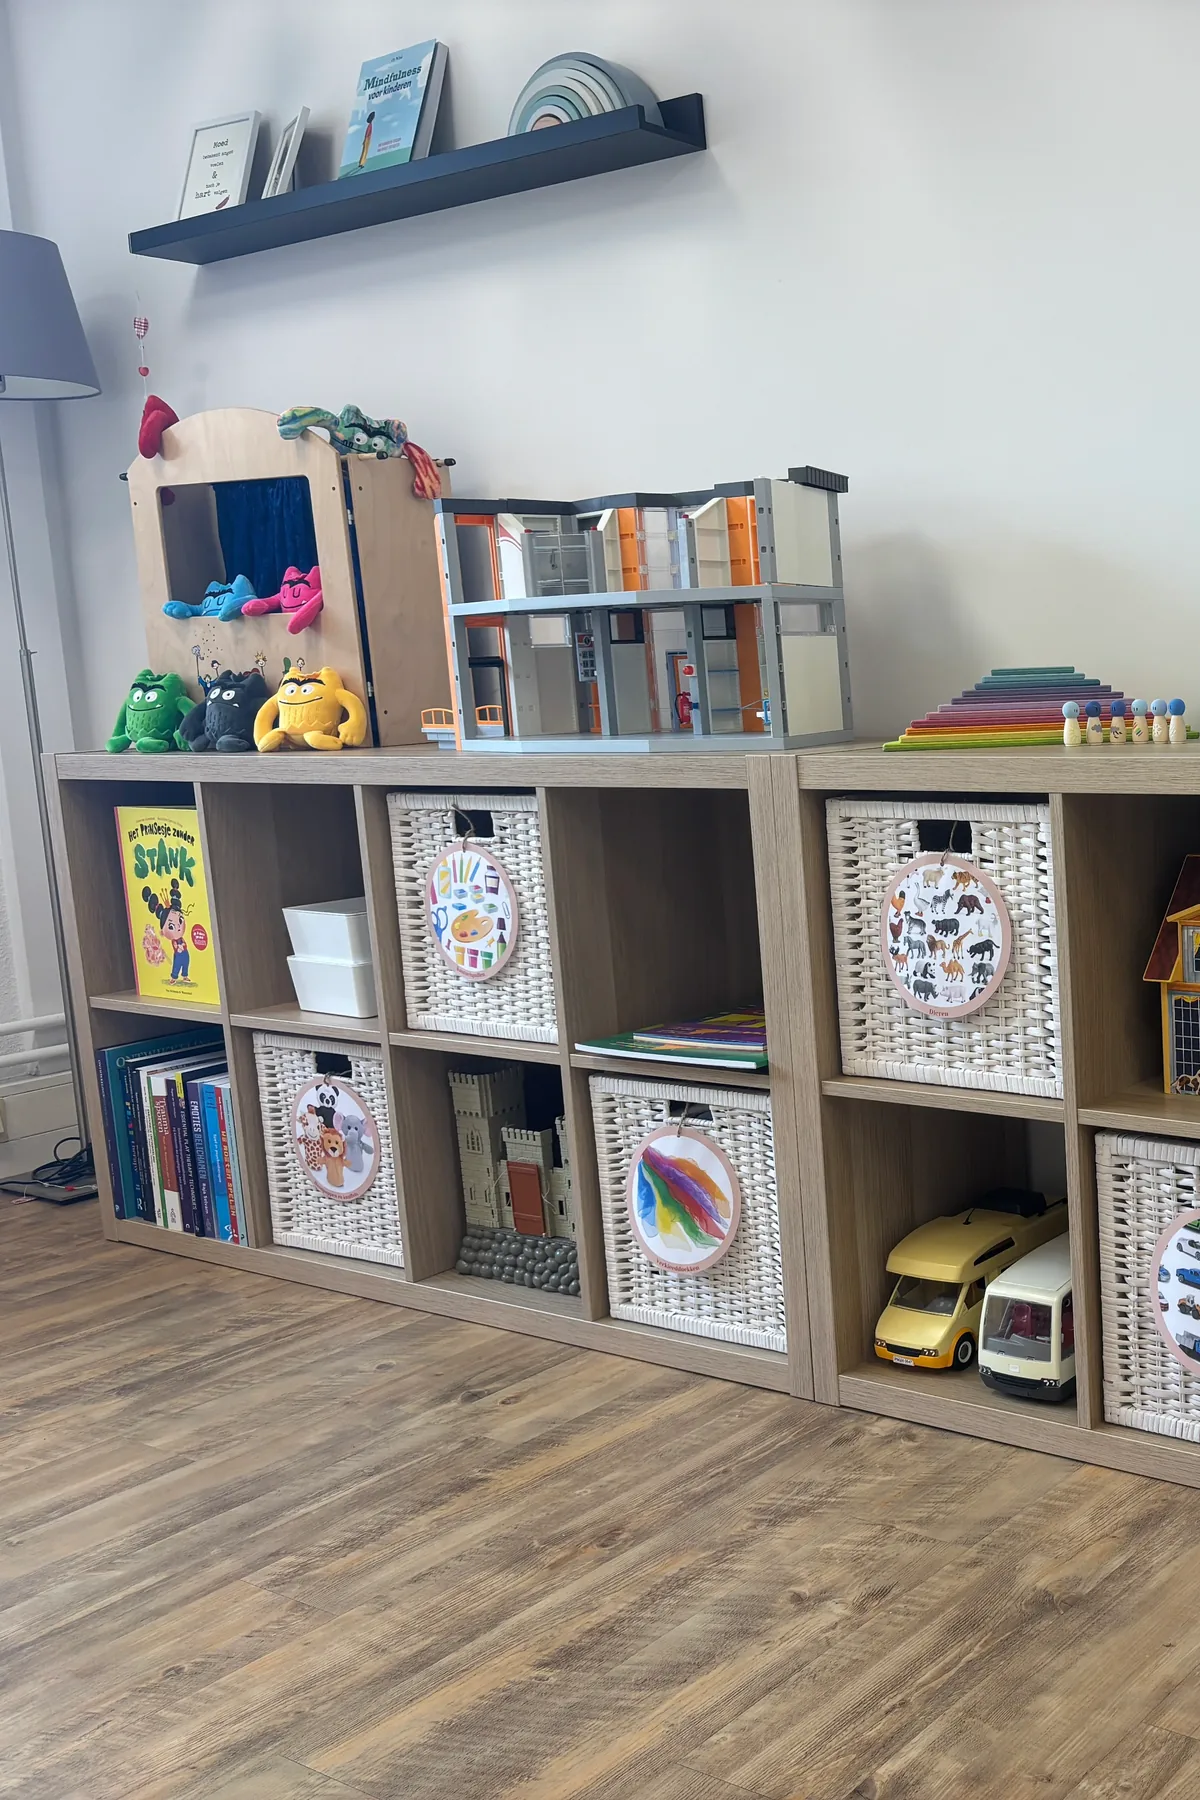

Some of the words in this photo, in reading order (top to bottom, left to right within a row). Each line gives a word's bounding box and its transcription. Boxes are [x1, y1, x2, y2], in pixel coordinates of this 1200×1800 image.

[364, 65, 422, 91] Mindfulness
[368, 90, 384, 101] voor
[383, 80, 412, 97] kinderen
[212, 170, 218, 179] &
[134, 838, 196, 888] STANK
[929, 1008, 949, 1017] Dieren
[154, 1101, 164, 1133] sporen
[159, 1098, 170, 1135] Trauma
[180, 1110, 188, 1137] ESSENTIAL
[190, 1100, 202, 1133] EMOTIES
[194, 1133, 207, 1180] BELICHAMEN
[228, 1182, 236, 1217] SPELEN
